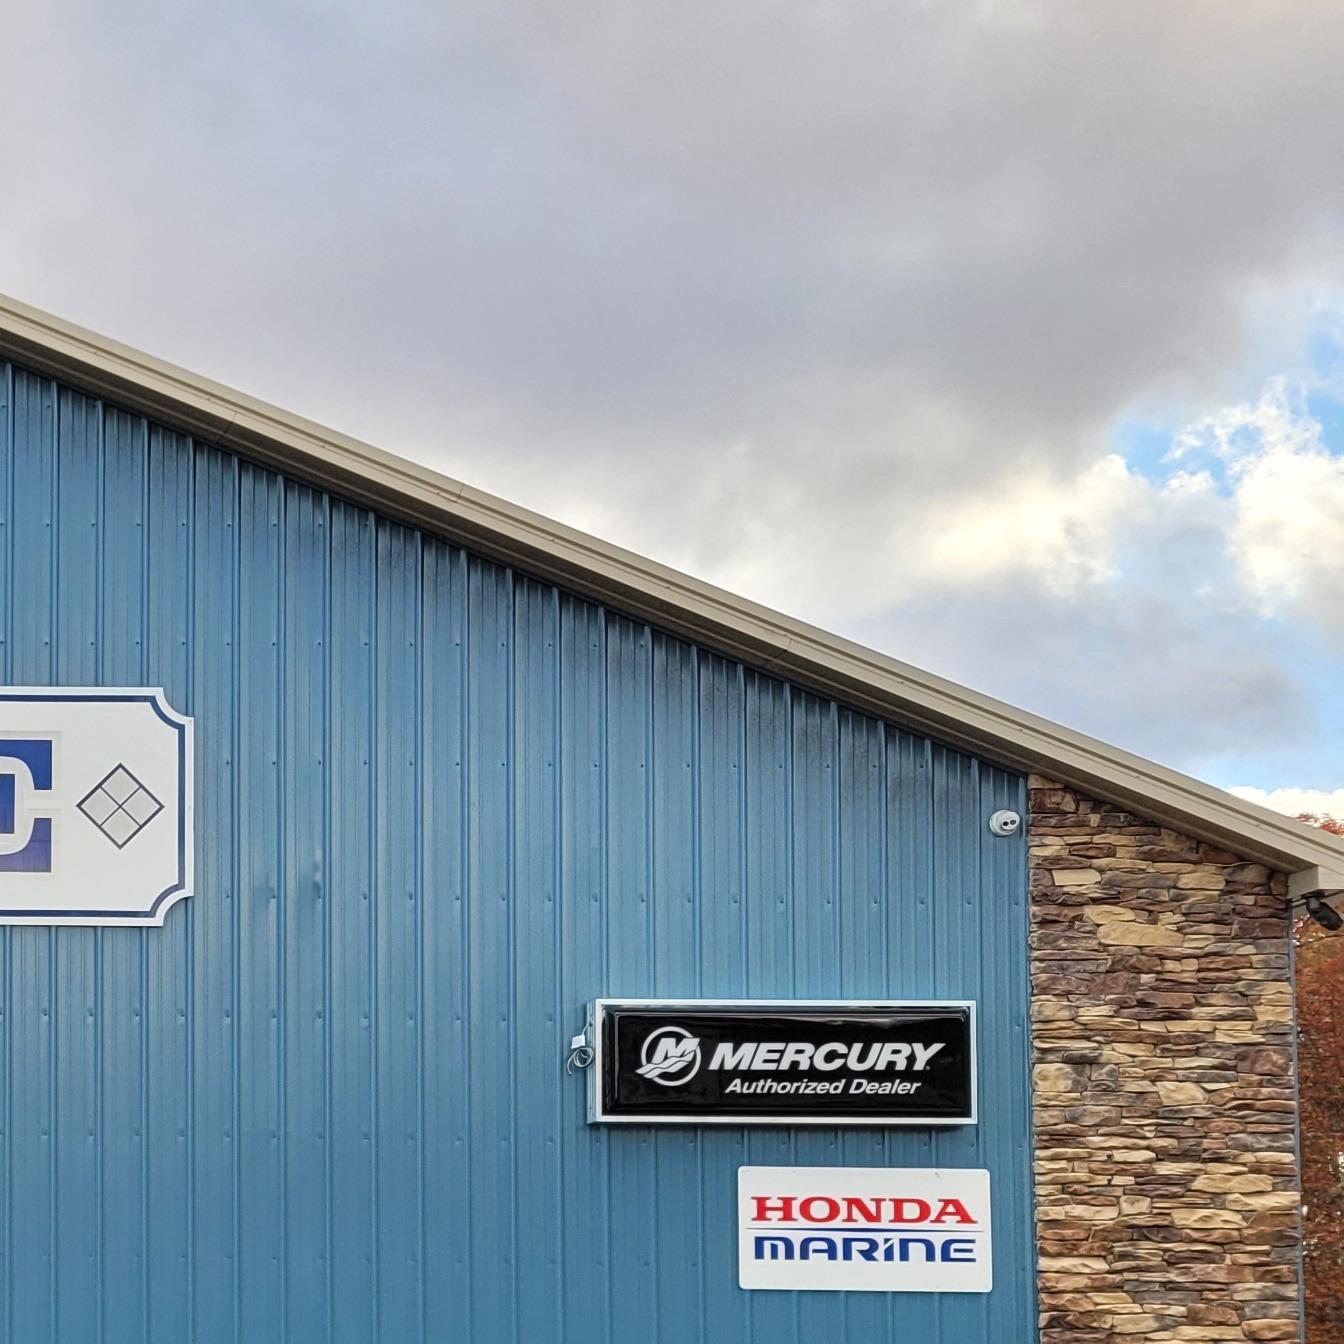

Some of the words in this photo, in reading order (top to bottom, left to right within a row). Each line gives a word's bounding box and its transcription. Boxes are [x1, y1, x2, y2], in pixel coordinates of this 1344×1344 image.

[707, 1042, 947, 1072] MERCURY
[724, 1078, 846, 1096] Authorized
[848, 1078, 922, 1096] Dealer
[750, 1195, 979, 1225] HONDA
